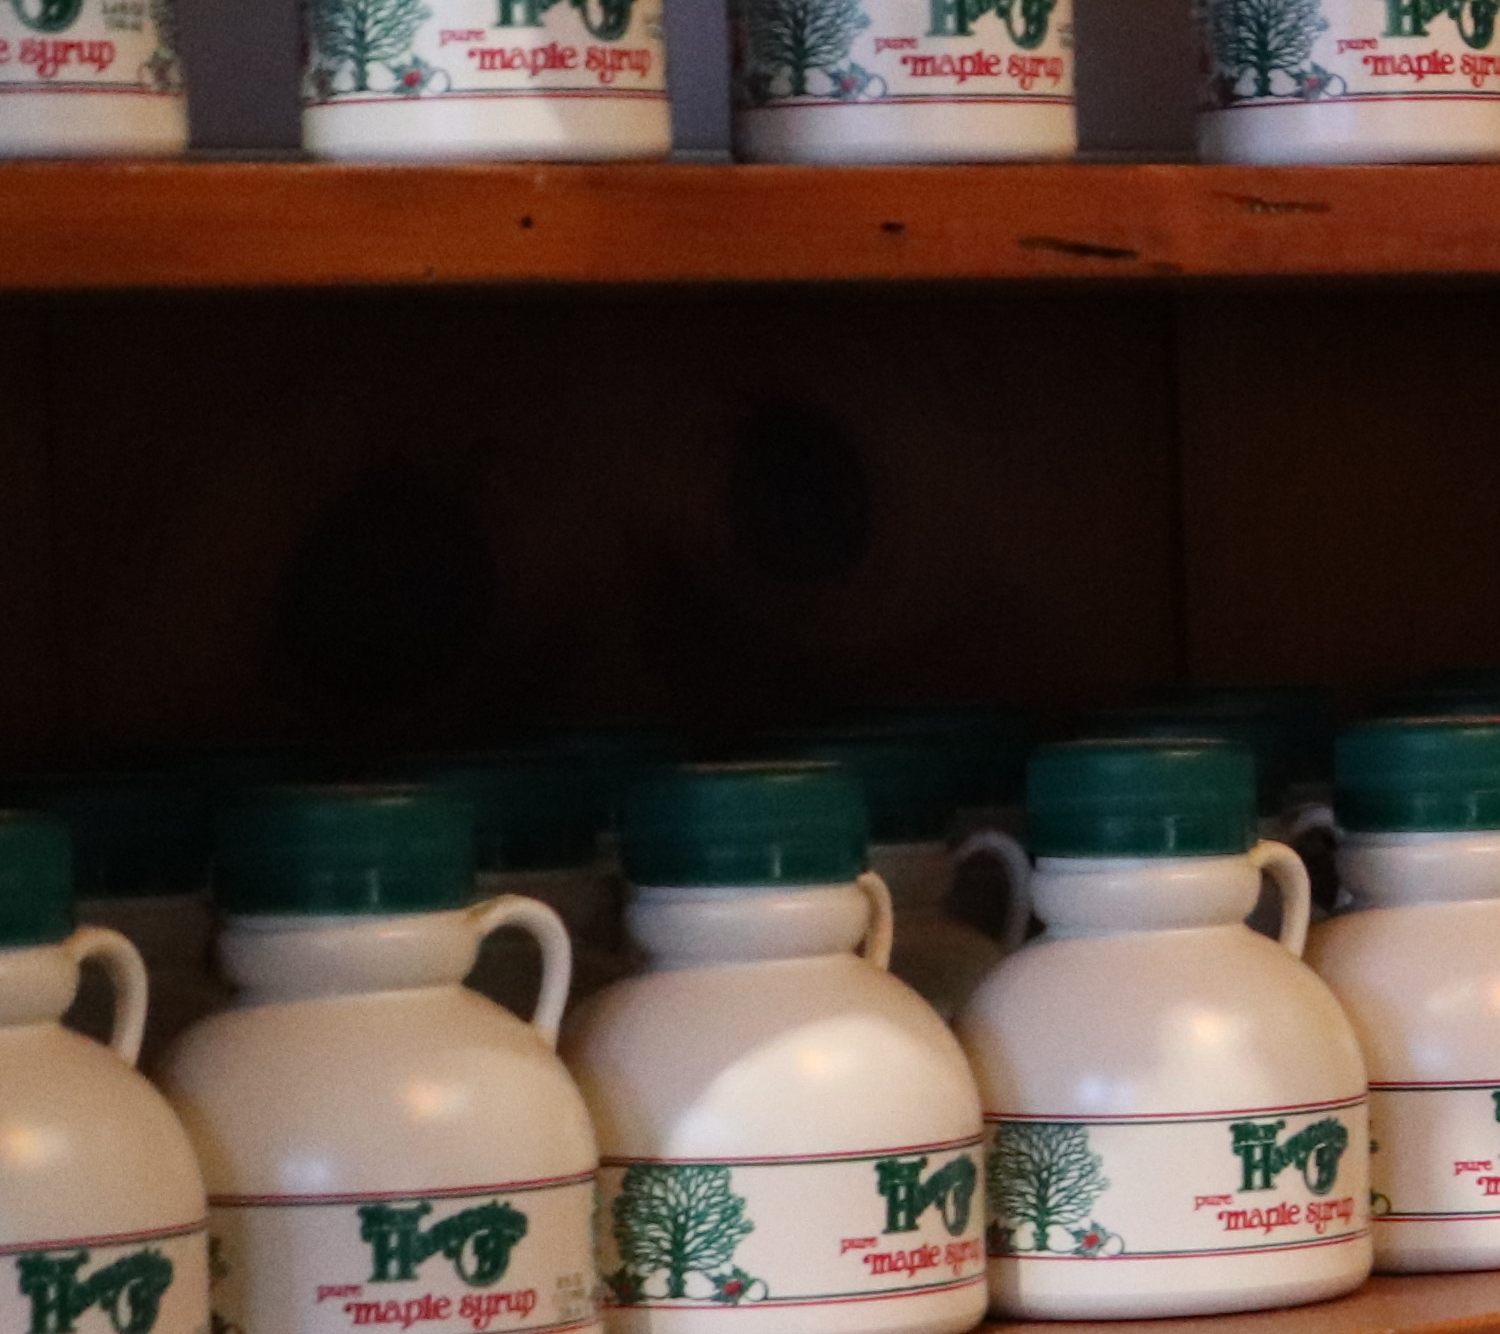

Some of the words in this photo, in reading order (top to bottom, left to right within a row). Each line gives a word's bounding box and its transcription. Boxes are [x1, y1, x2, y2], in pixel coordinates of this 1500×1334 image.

[19, 38, 116, 77] syrup
[468, 41, 578, 78] maple
[1337, 38, 1378, 54] pure
[902, 50, 1002, 84] maple
[1362, 49, 1455, 83] maple
[1454, 1160, 1493, 1176] pure
[1194, 1194, 1234, 1211] pure
[1217, 1201, 1302, 1235] maple
[863, 1243, 942, 1278] maple
[344, 1293, 452, 1329] maple
[459, 1288, 538, 1329] syrup
